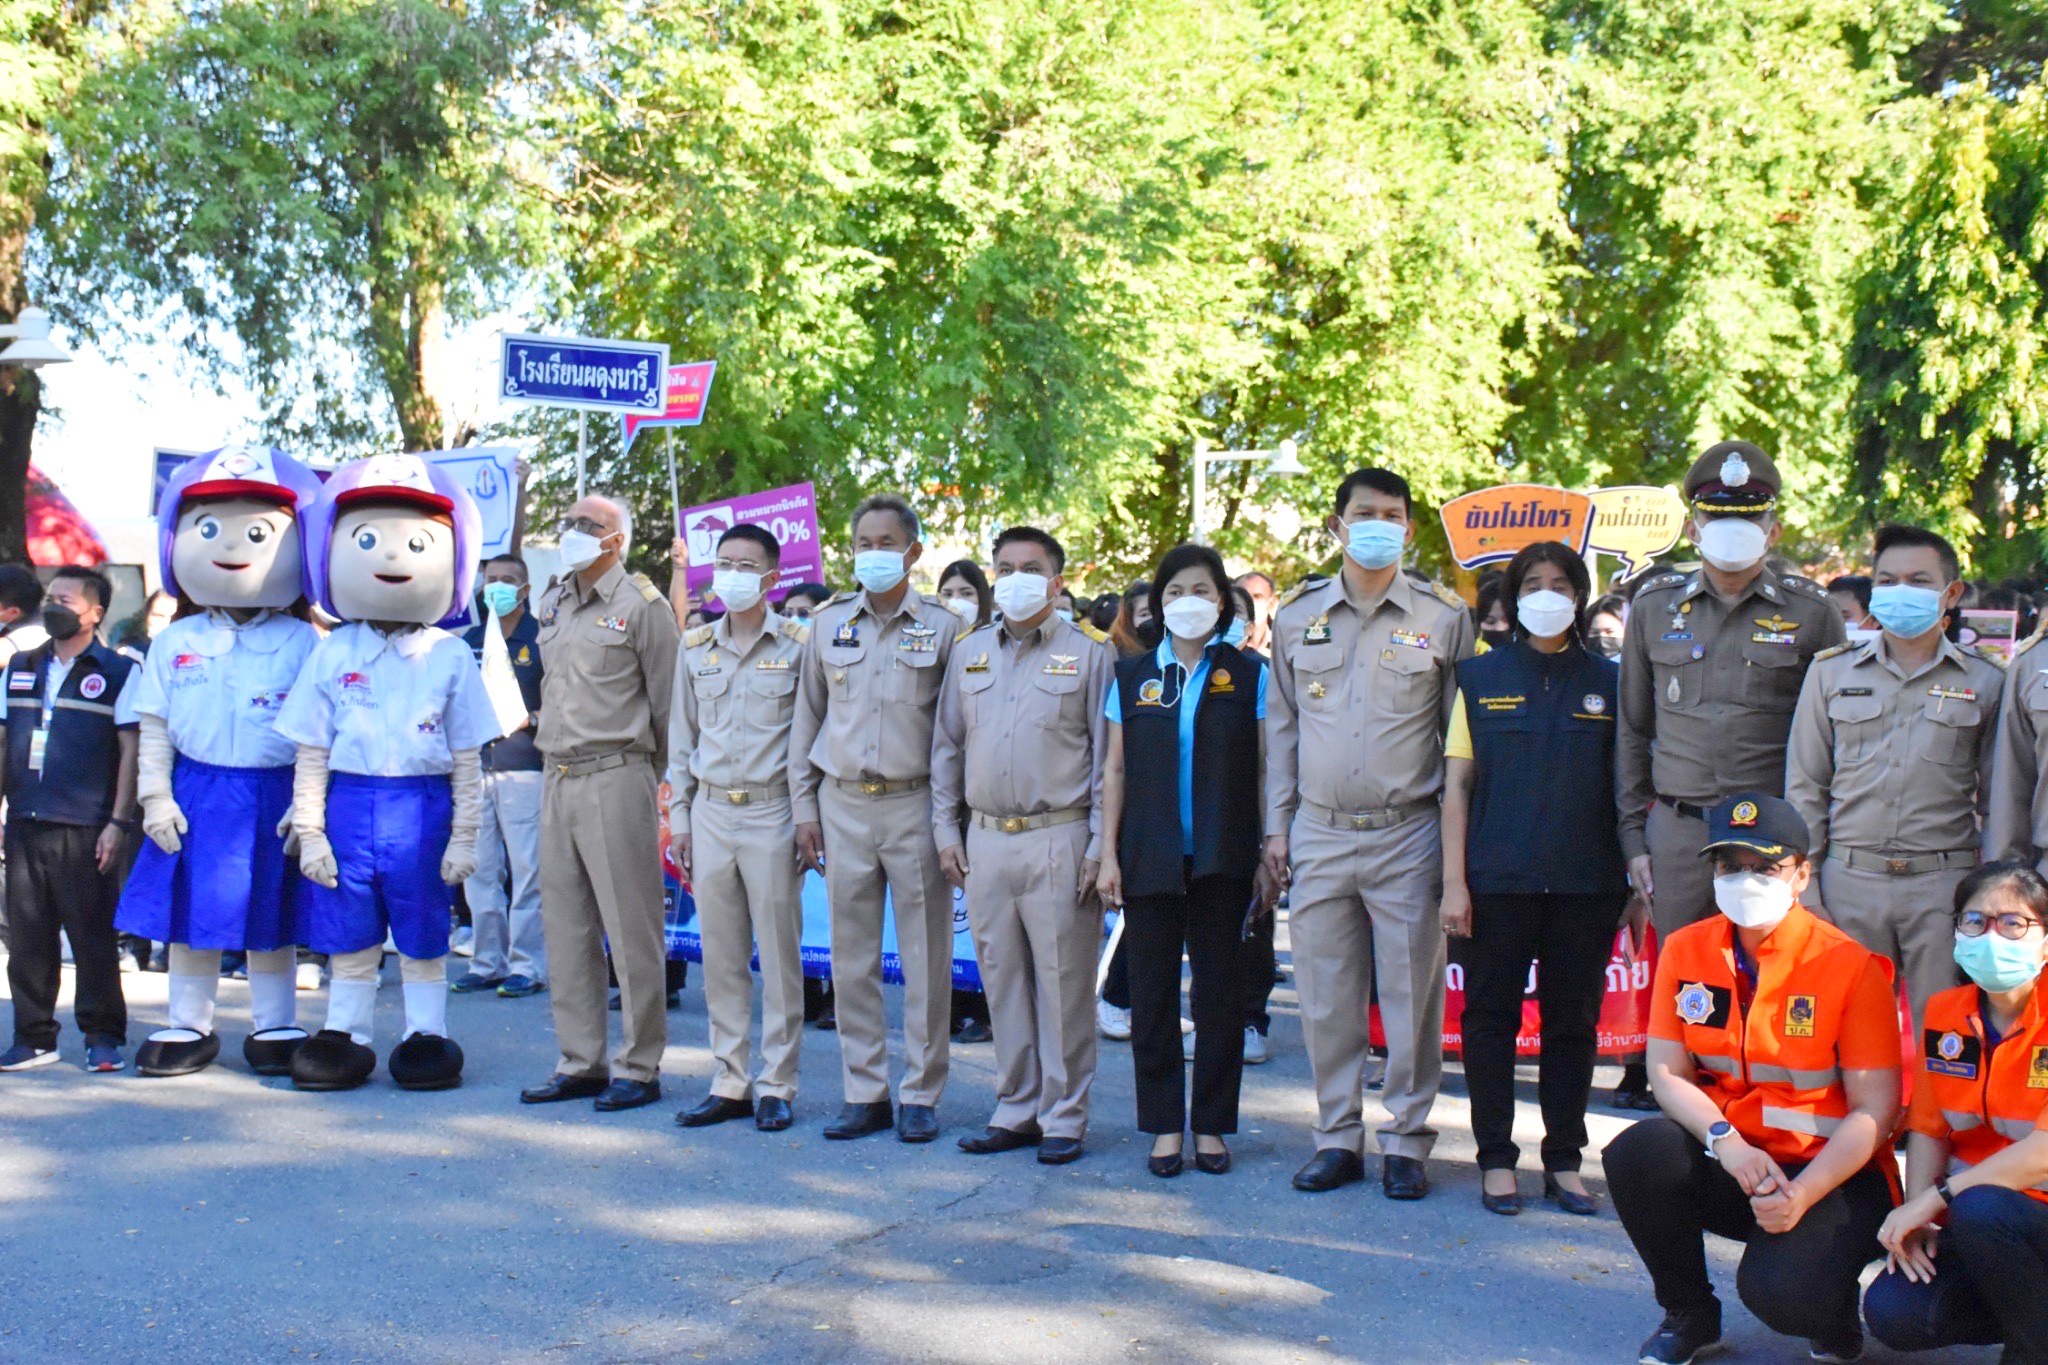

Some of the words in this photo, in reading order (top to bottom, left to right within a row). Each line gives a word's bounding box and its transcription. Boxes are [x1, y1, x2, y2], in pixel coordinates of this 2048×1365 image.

[518, 348, 650, 398] โรงเรียนผดุงนารี
[736, 495, 809, 521] สวมหมวกนิรภัย
[1465, 499, 1573, 530] ขับไม่โทร
[1596, 506, 1669, 527] วงไม่ขับ
[755, 516, 811, 546] 0%
[1596, 1031, 1647, 1048] ย์อำนวย
